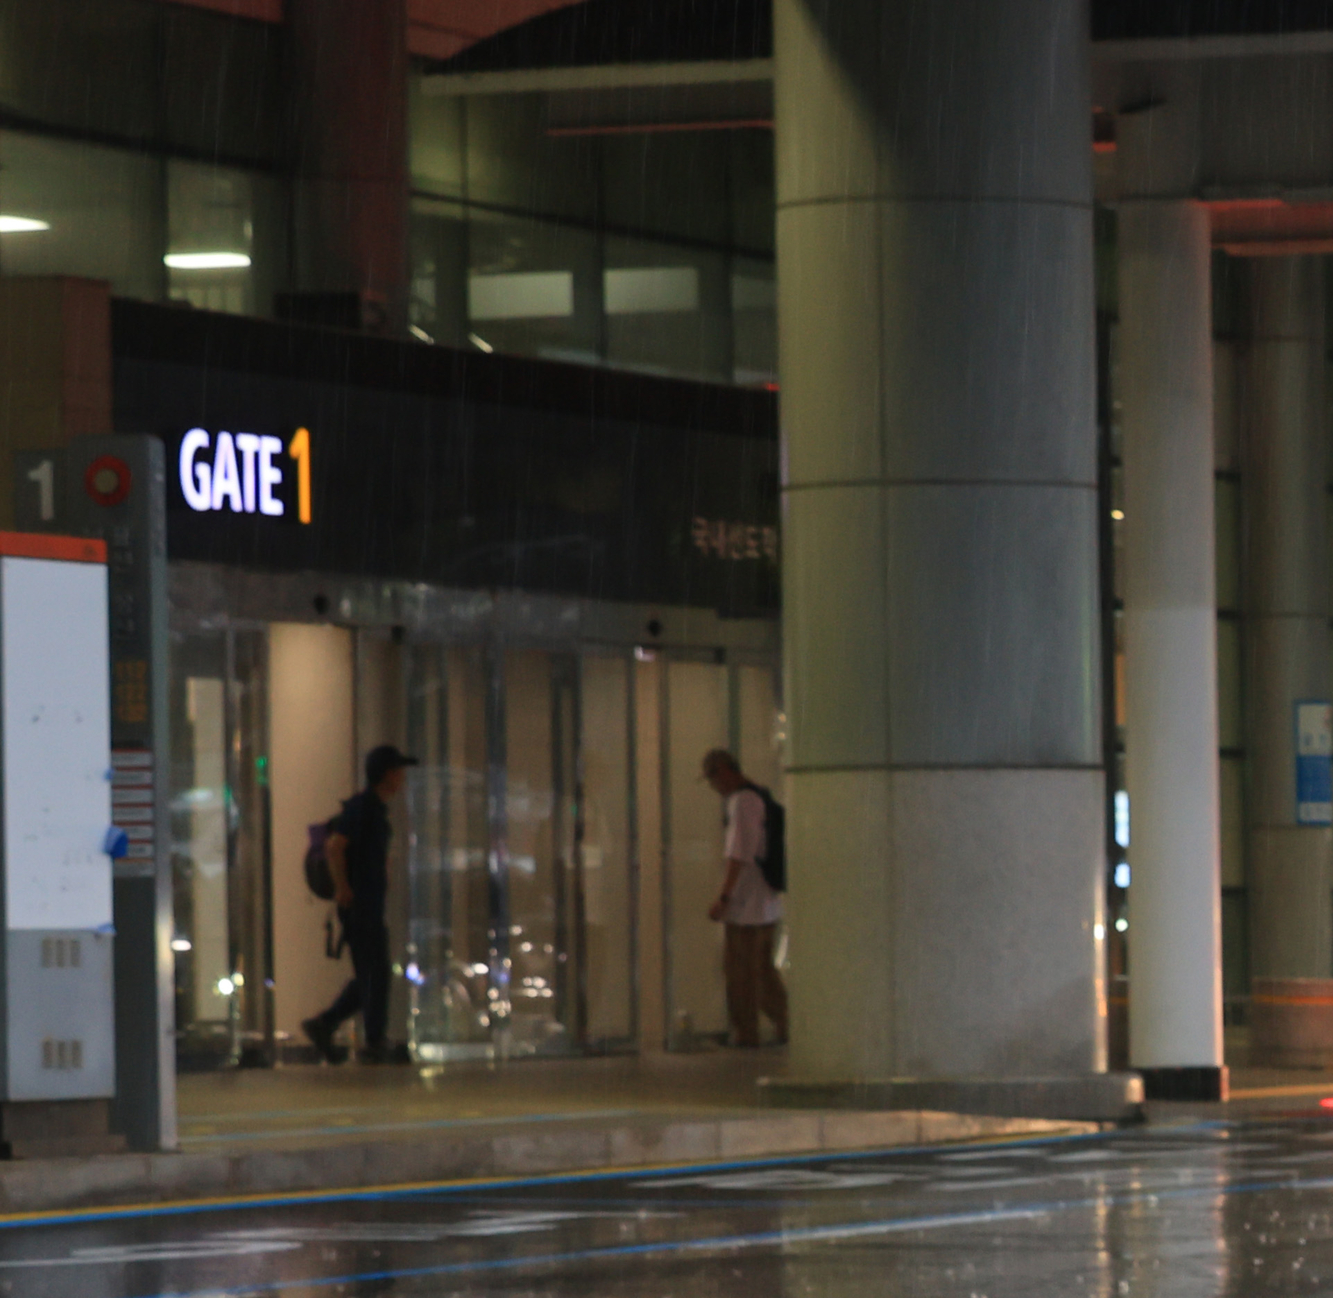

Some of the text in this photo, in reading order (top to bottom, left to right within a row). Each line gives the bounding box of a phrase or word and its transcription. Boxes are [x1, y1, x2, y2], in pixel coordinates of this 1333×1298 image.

[27, 459, 54, 521] 1
[179, 426, 312, 525] GATE 1
